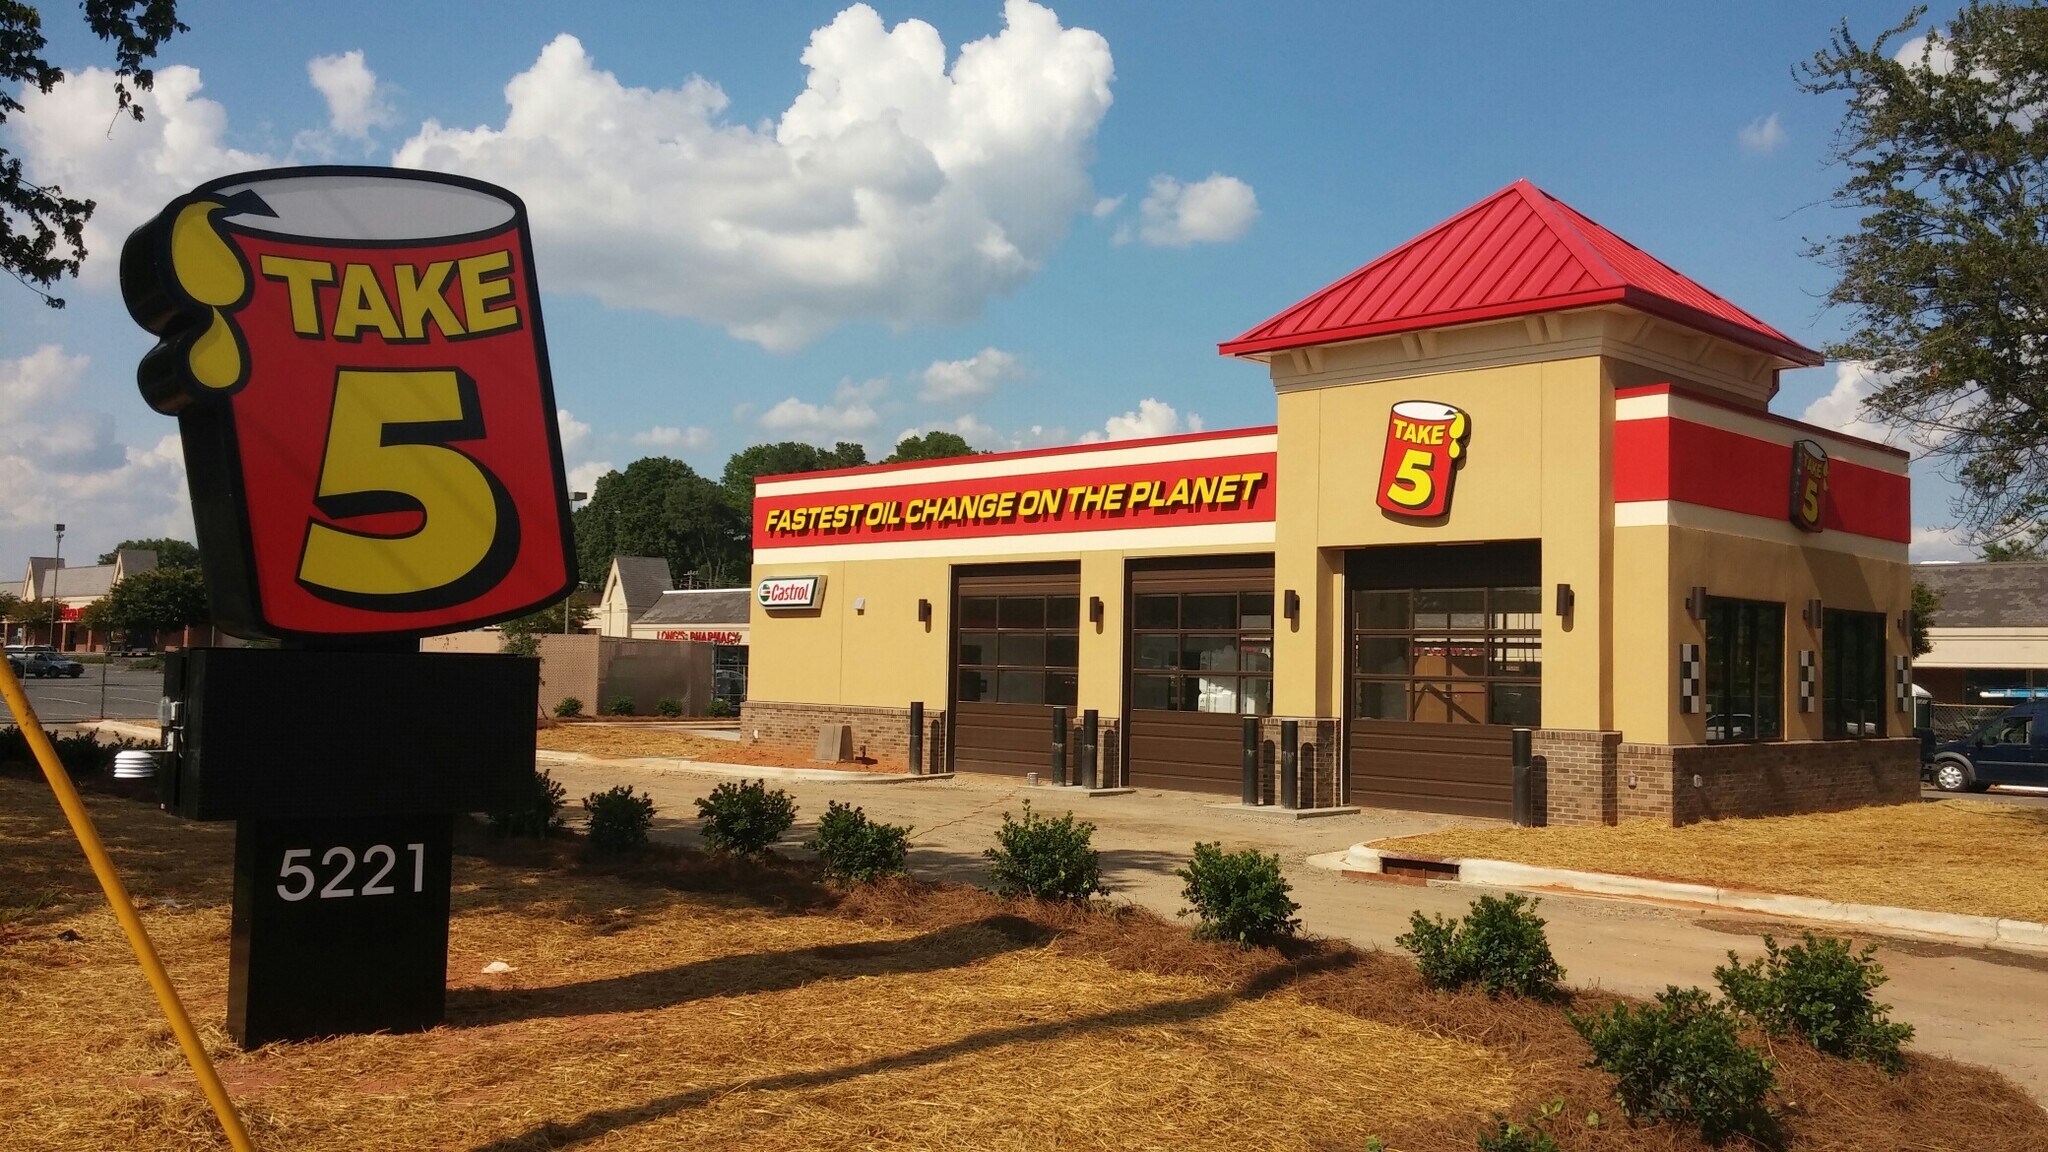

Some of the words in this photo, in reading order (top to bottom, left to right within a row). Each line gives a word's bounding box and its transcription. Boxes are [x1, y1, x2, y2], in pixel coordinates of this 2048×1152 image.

[260, 249, 521, 341] TAKE
[1393, 418, 1446, 445] TAKE
[297, 368, 510, 602] 5
[765, 503, 865, 532] FASTEST
[865, 501, 901, 526] OIL
[905, 491, 1017, 524] CHANGE
[1018, 488, 1063, 516] ON
[1068, 483, 1128, 513] THE
[1128, 472, 1263, 509] PLANET
[1386, 448, 1433, 507] 5
[1802, 478, 1819, 522] 5
[771, 583, 810, 602] Castrol
[690, 631, 741, 644] PHARMACY
[276, 843, 424, 902] 5221
